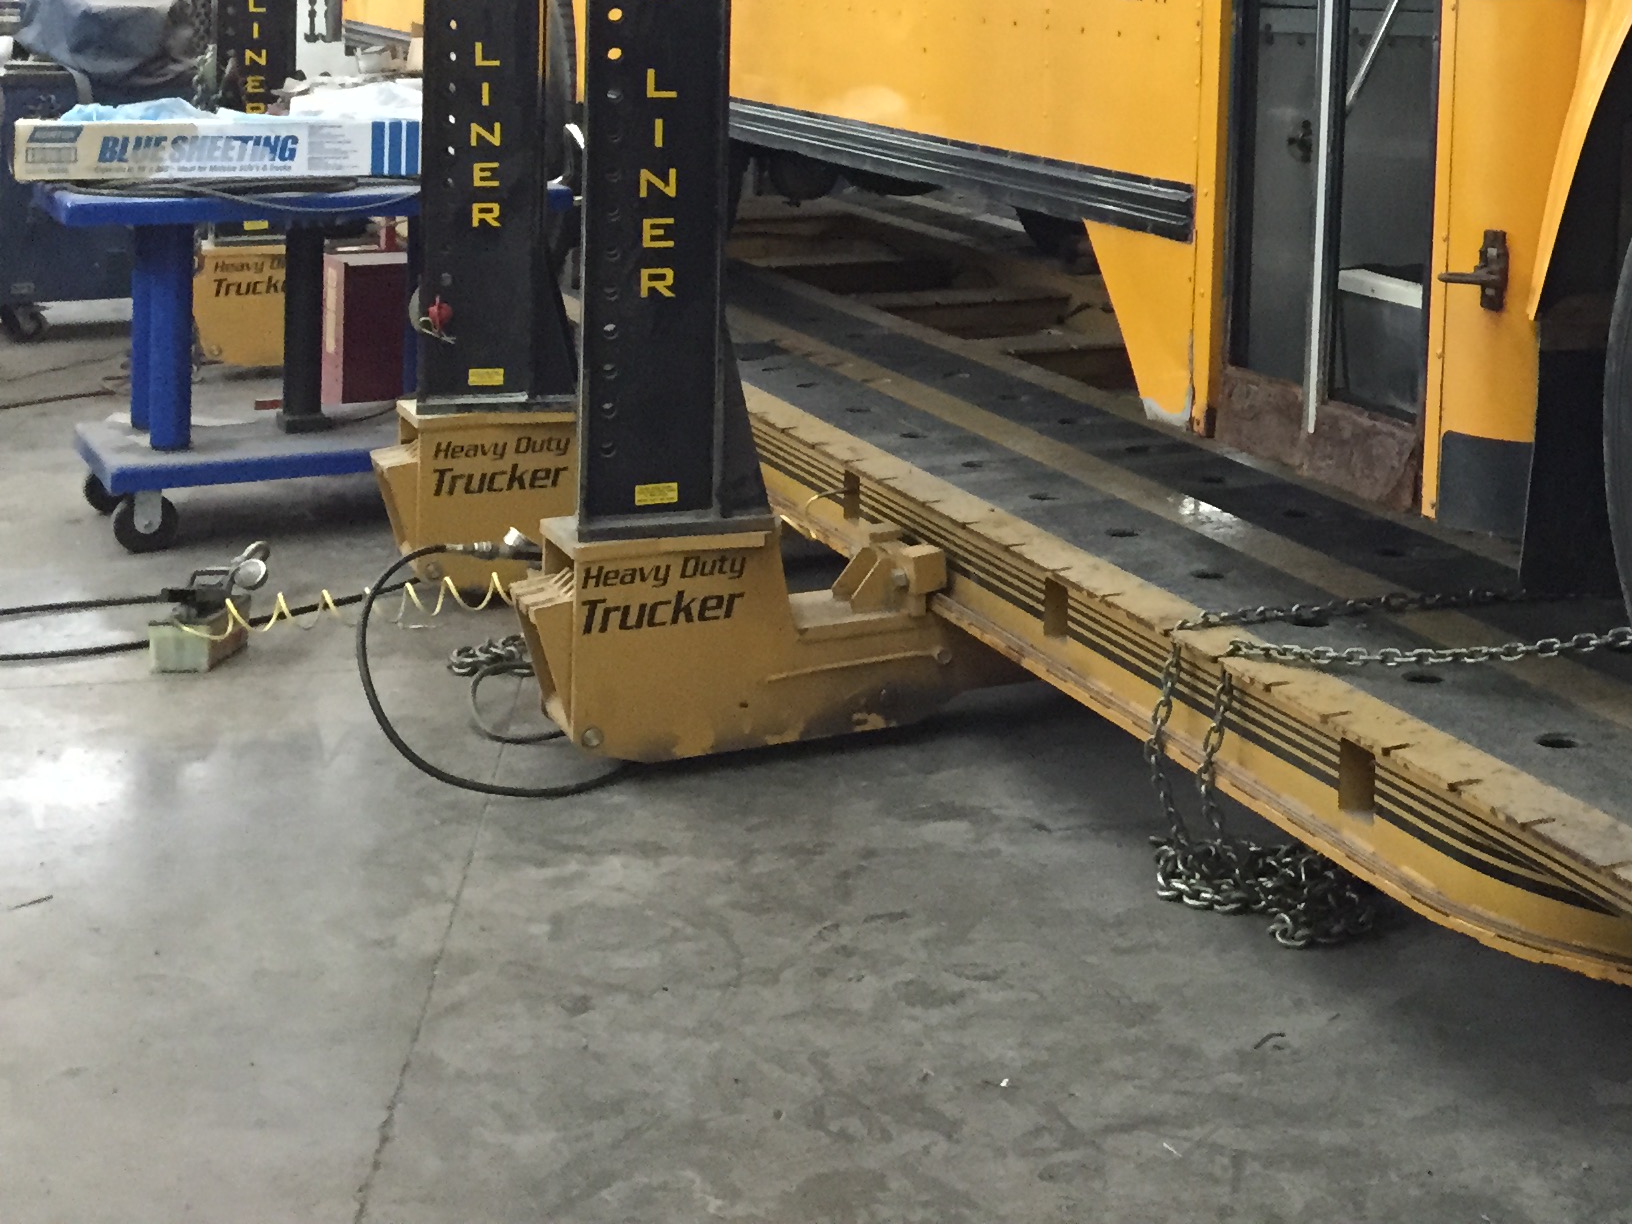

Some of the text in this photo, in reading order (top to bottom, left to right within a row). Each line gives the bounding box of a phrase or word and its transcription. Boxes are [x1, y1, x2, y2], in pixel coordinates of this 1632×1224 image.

[98, 135, 168, 163] BLUE
[168, 134, 300, 164] SHEETING
[470, 41, 502, 228] LINER
[639, 67, 678, 299] LINER
[213, 260, 265, 274] Heavy
[213, 275, 286, 298] Truck
[432, 435, 571, 461] Heavy Duty
[432, 463, 569, 497] Trucker
[581, 554, 748, 590] Heavy Duty
[581, 589, 746, 636] Trucker
